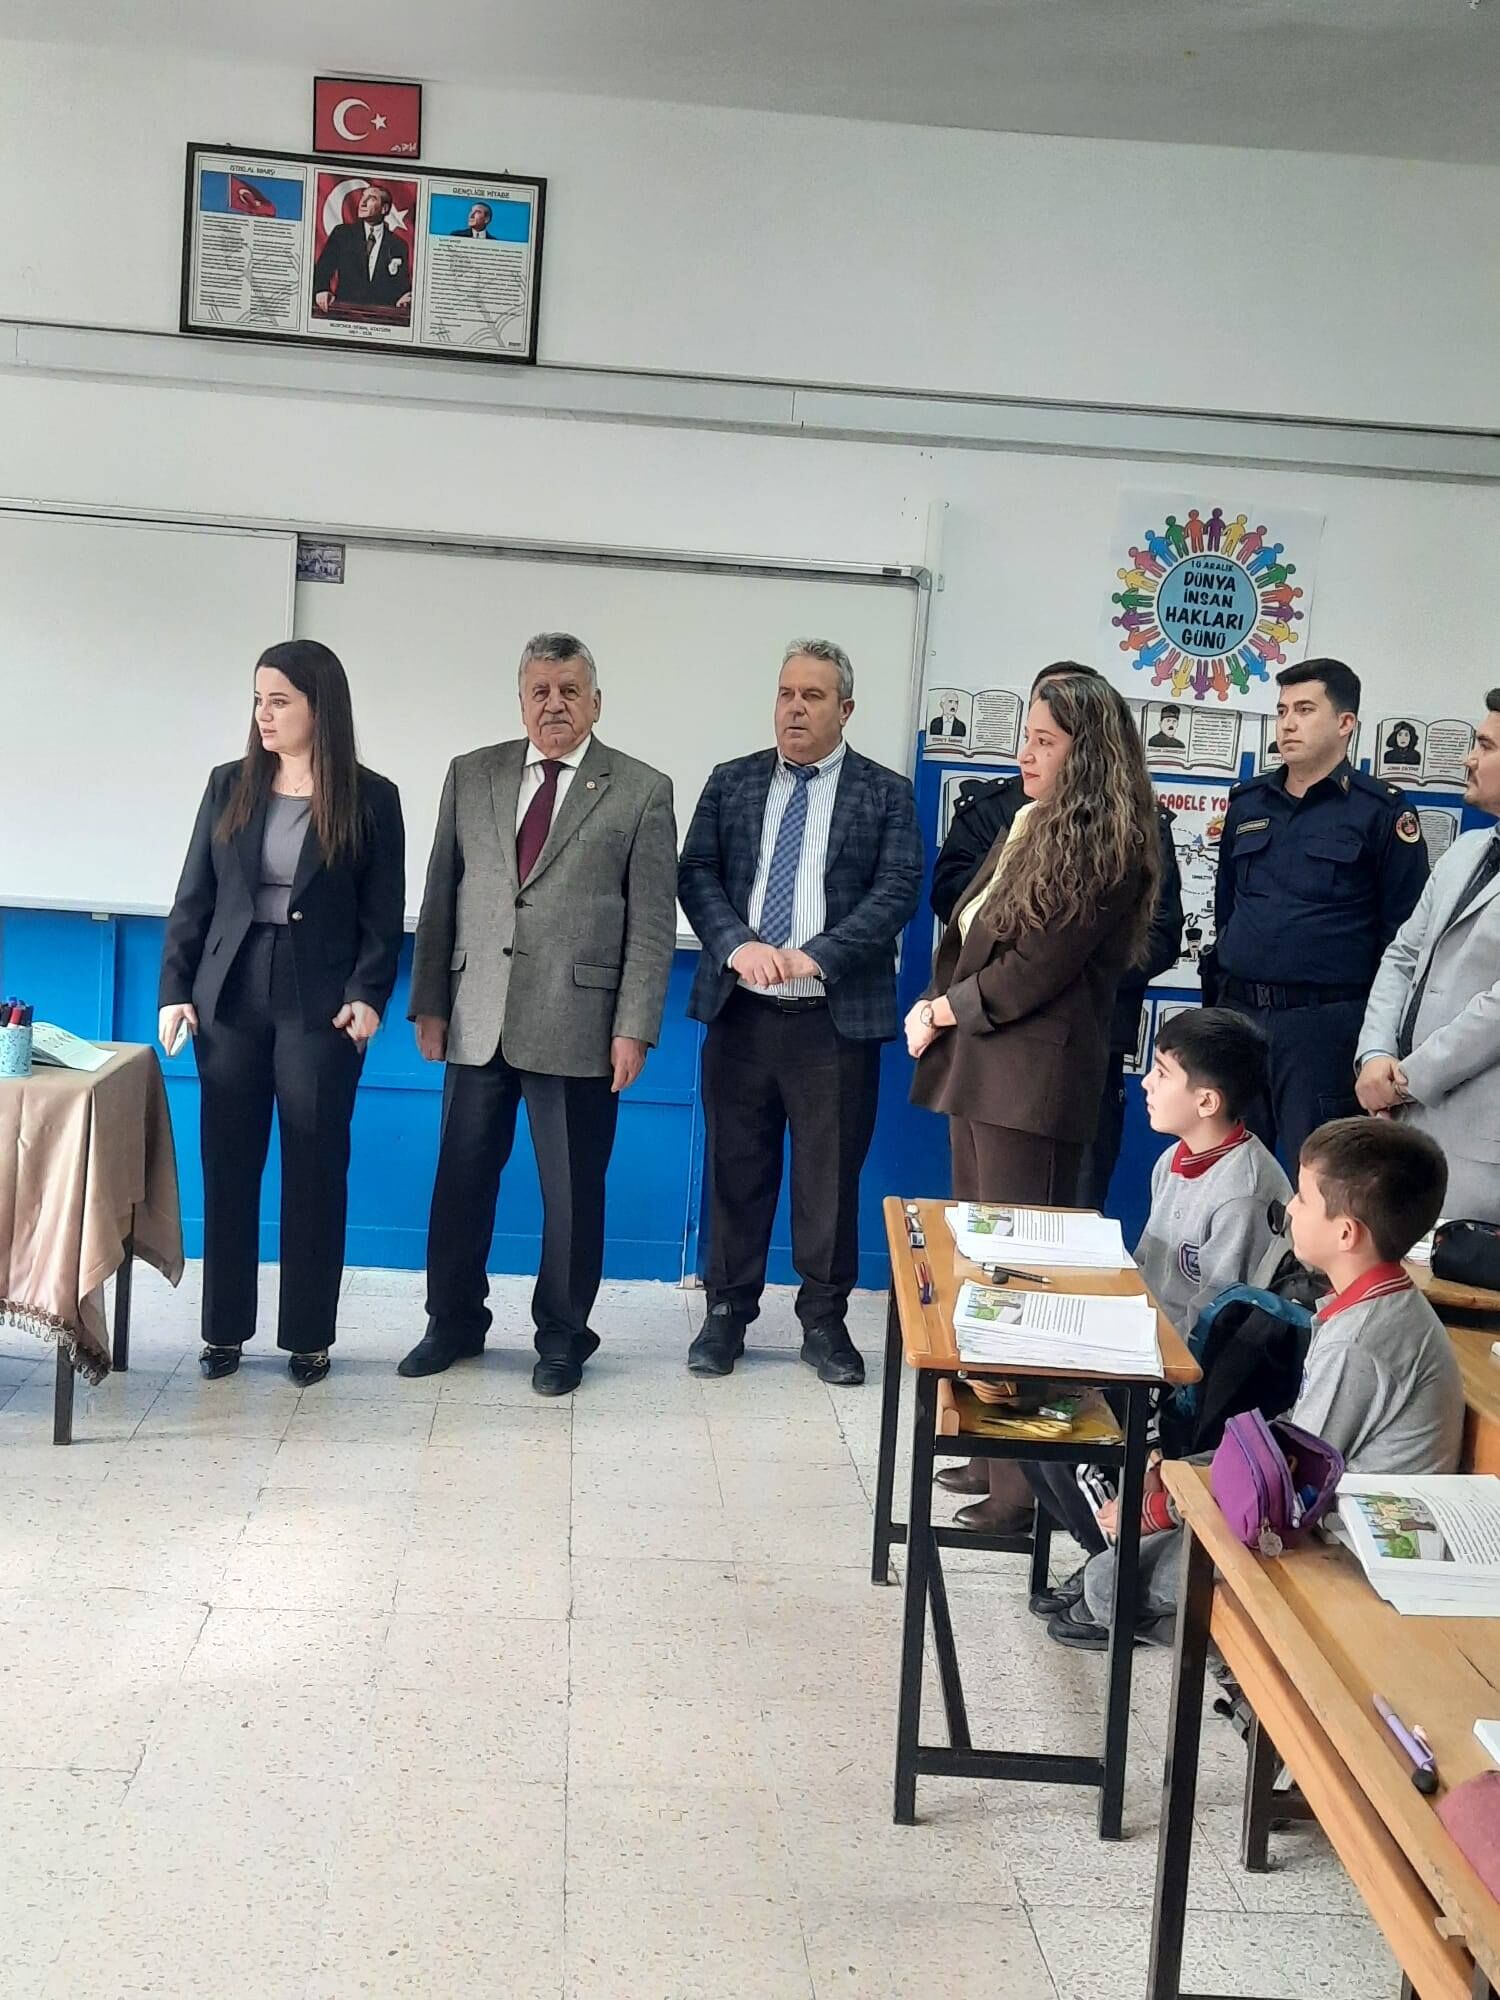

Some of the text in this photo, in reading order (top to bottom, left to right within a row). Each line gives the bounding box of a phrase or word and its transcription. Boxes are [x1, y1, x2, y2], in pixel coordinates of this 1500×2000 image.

[1191, 560, 1234, 572] 10 ARALIK
[1184, 571, 1236, 592] DÜNYA
[1183, 588, 1233, 608] İNSAN
[1165, 606, 1244, 630] HAKLARI
[1181, 628, 1226, 649] GÜNÜ
[1156, 793, 1229, 813] CADELE YO
